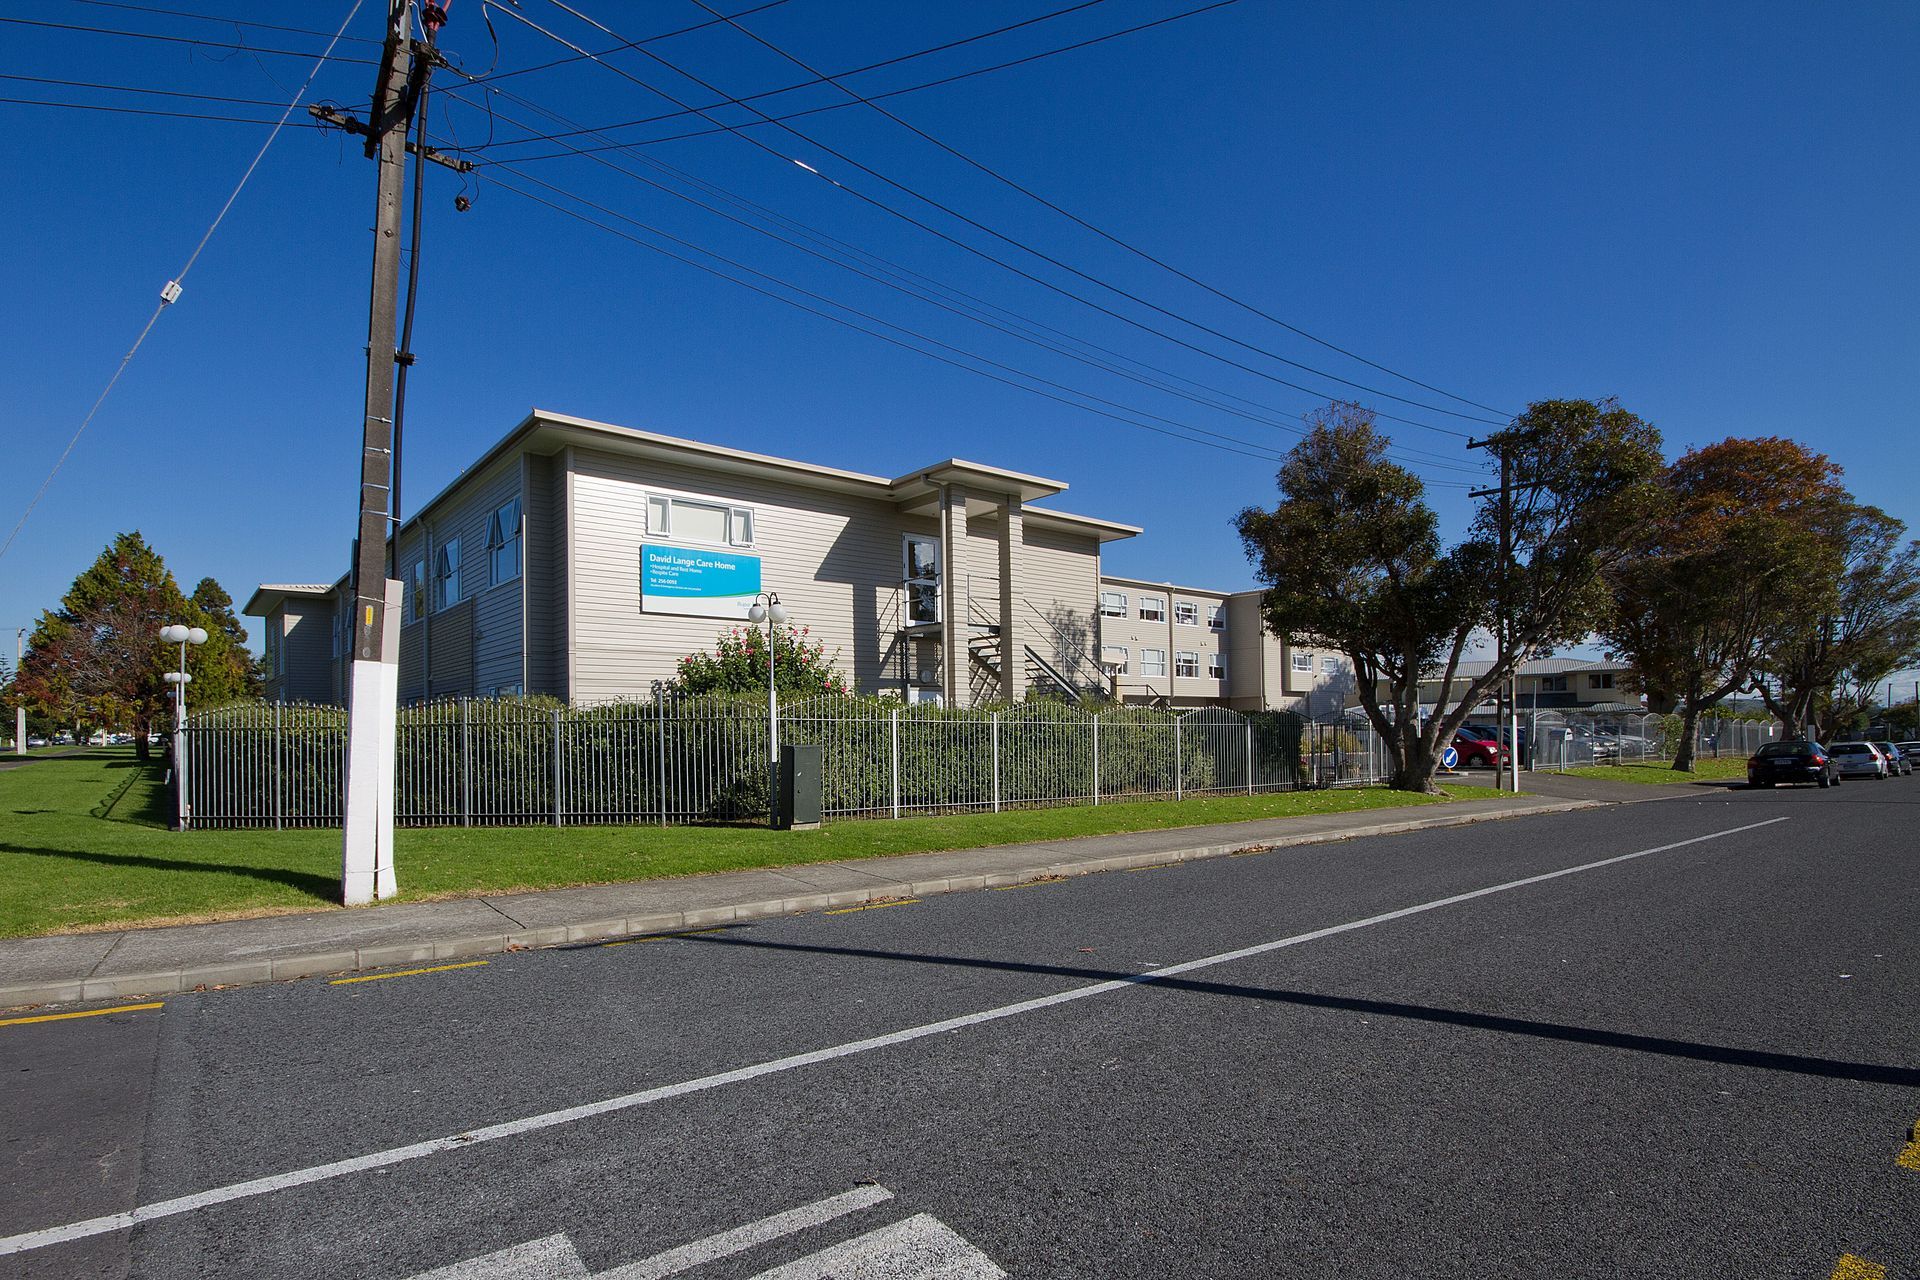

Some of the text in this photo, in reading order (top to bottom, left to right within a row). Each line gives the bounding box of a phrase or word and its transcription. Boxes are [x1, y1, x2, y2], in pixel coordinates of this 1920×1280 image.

[650, 554, 736, 570] David Lange Care Home
